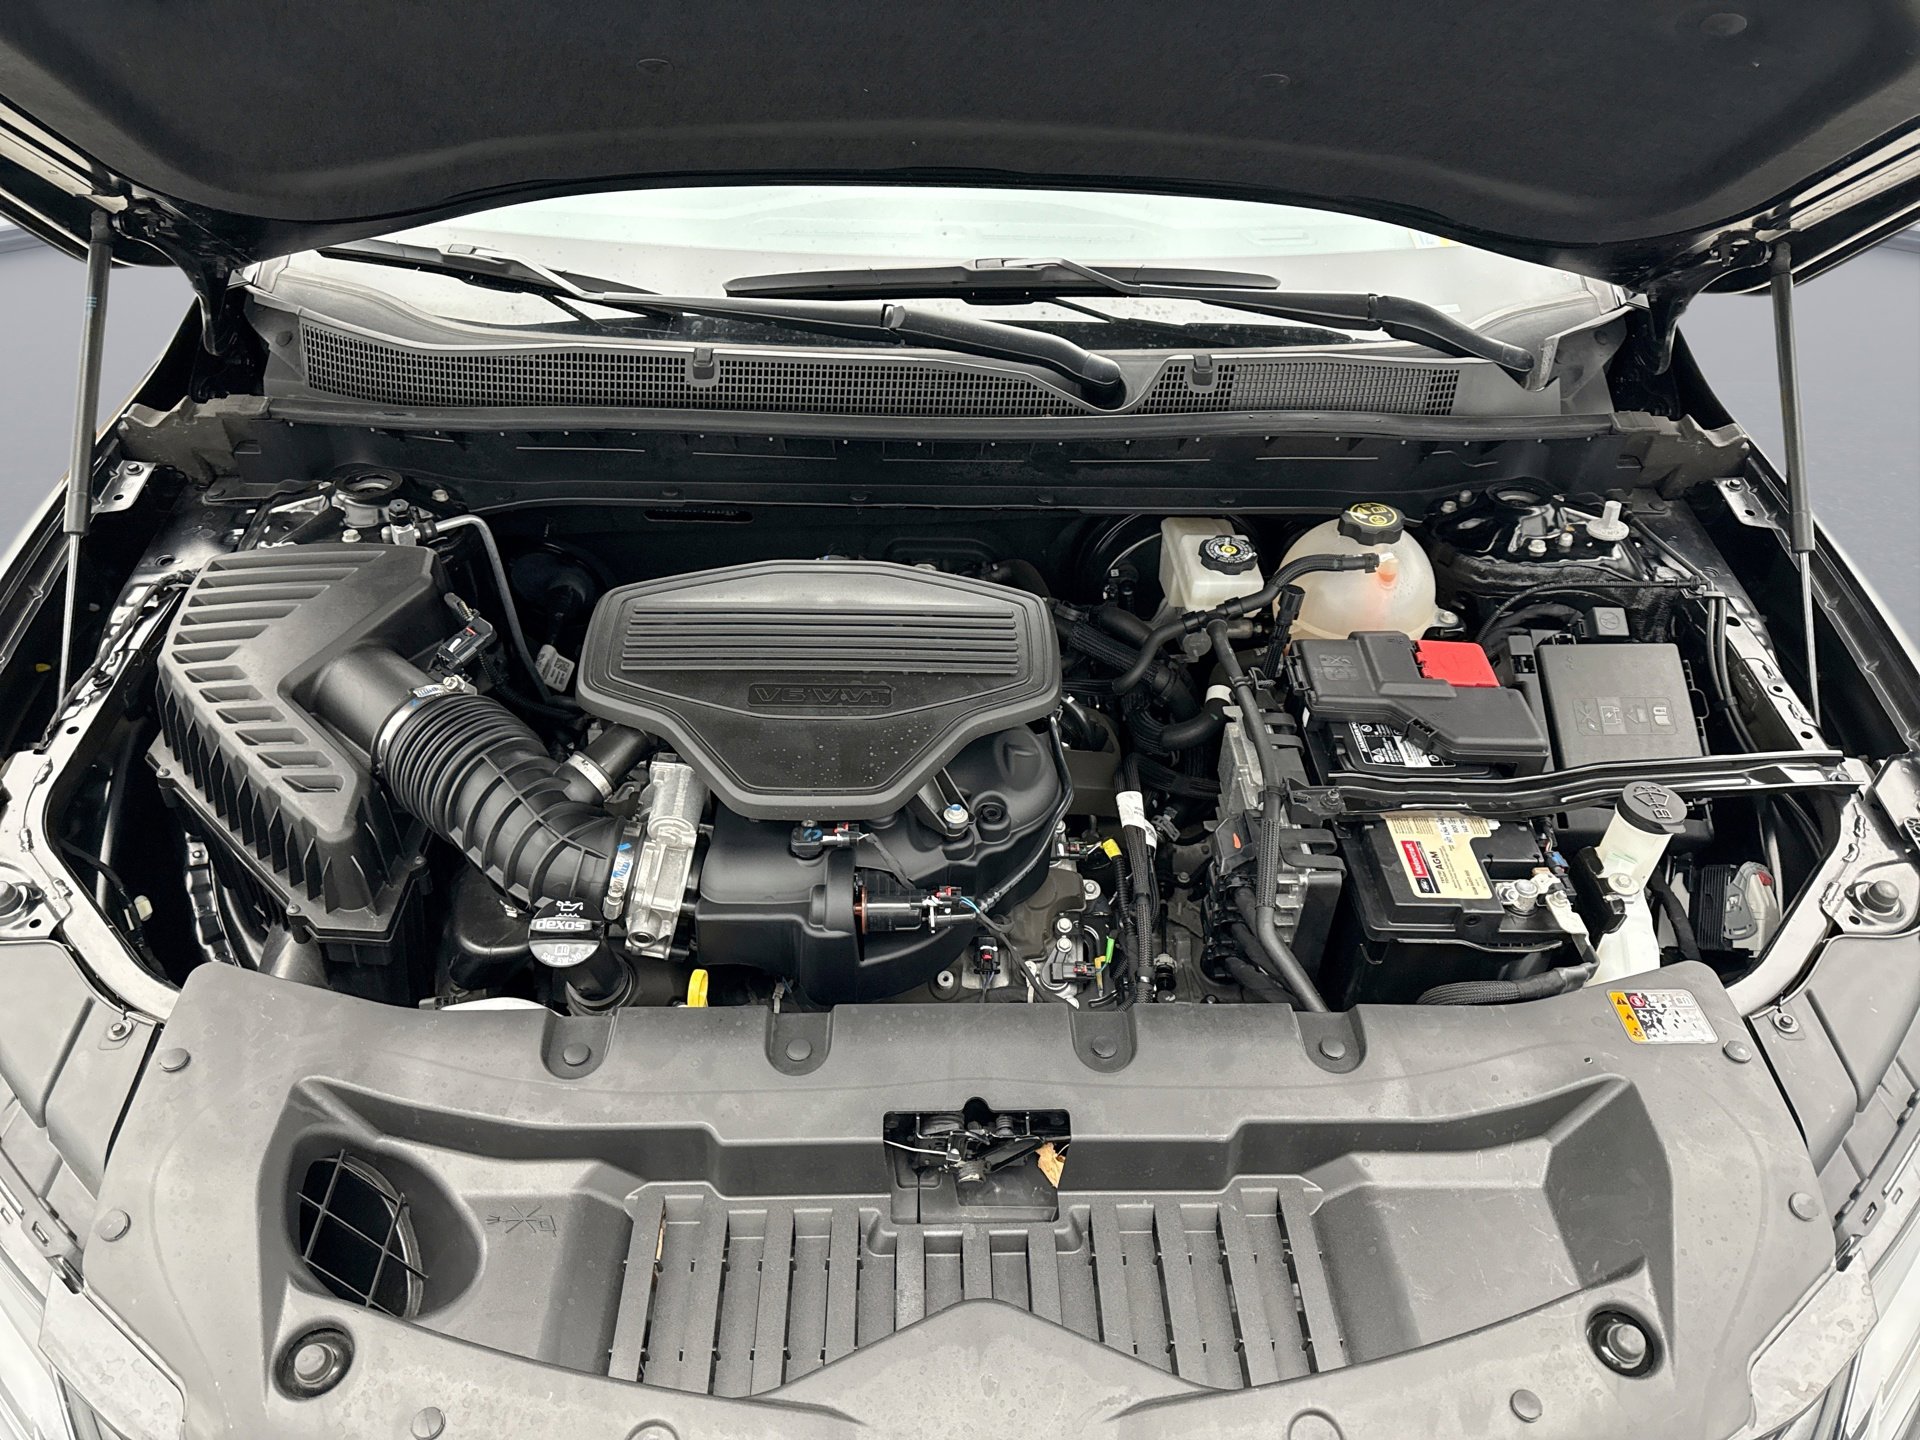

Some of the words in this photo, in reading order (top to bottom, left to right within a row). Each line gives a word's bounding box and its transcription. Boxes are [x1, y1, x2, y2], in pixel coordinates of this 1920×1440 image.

[754, 687, 806, 702] V6
[812, 688, 891, 703] VVT
[1404, 842, 1424, 874] Motorcraft
[1429, 851, 1444, 870] AGM
[535, 919, 586, 931] dexos
[540, 951, 556, 963] SAE
